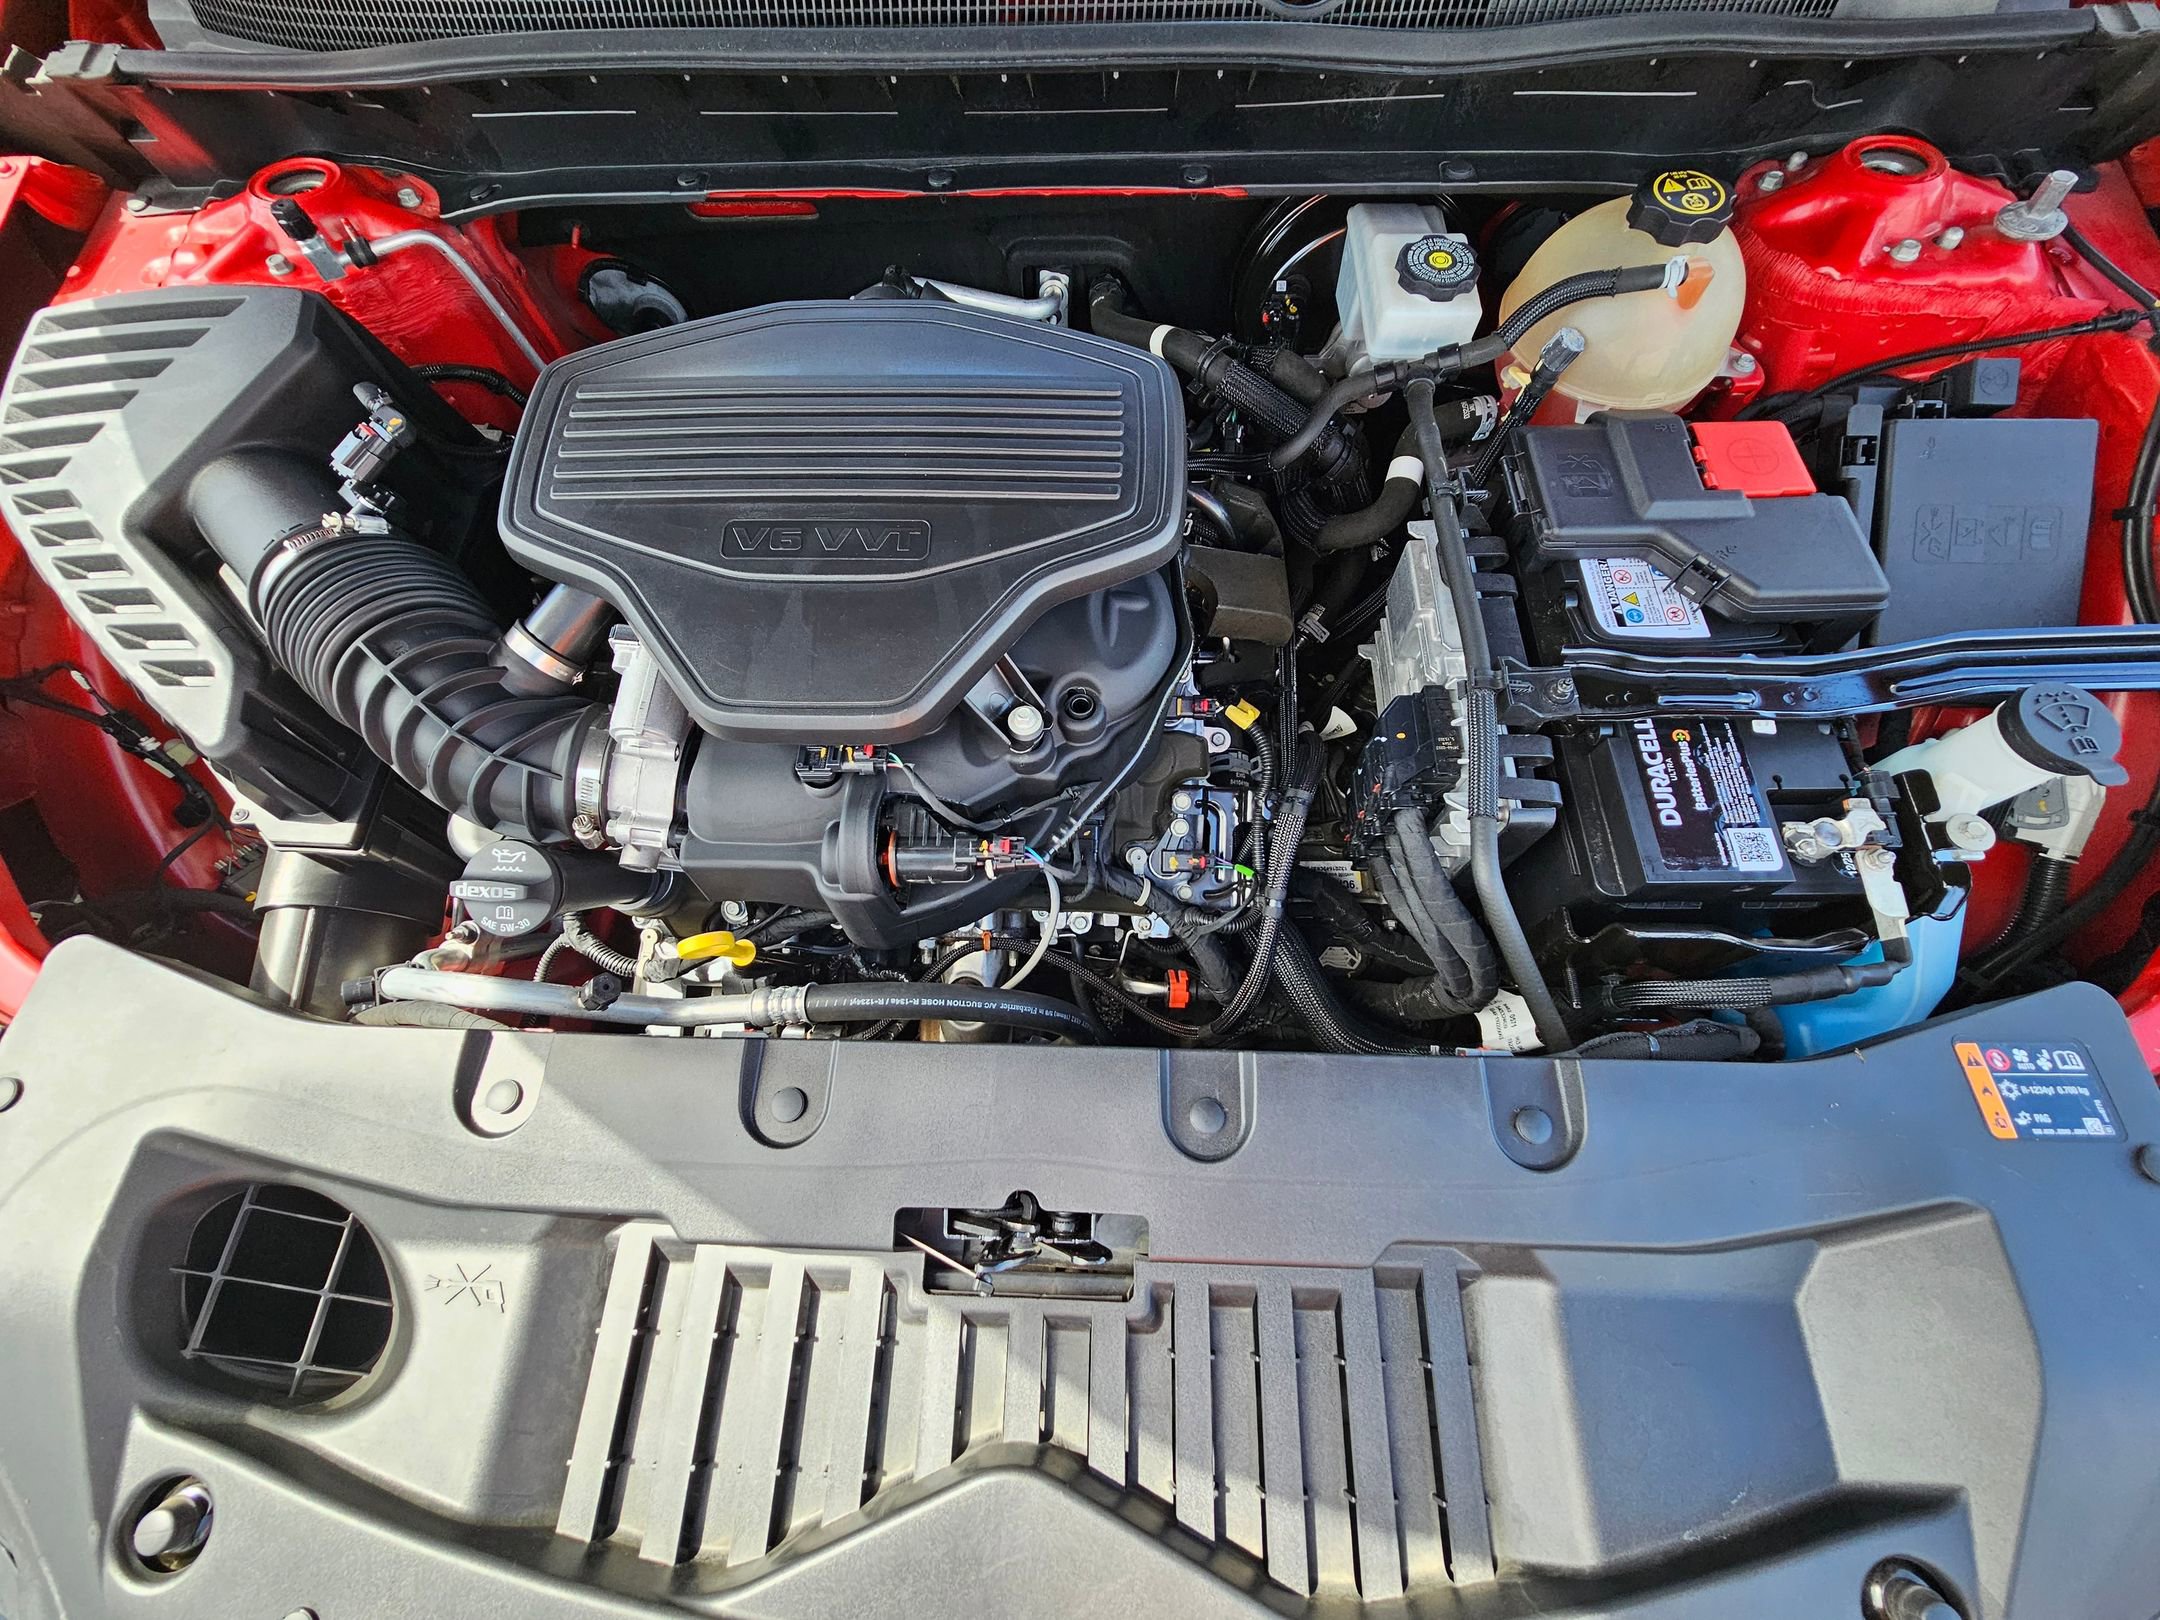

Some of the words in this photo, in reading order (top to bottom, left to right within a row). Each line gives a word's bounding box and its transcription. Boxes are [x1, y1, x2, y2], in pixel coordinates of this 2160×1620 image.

[733, 527, 802, 551] V6
[815, 527, 921, 551] VVT
[1634, 718, 1683, 826] DURACELL
[1665, 757, 1678, 781] ULTRA
[1840, 852, 1857, 874] 12/25
[455, 883, 517, 899] dexos
[481, 916, 497, 930] SAE
[500, 918, 530, 932] 5W-30
[921, 998, 945, 1006] HOSE
[946, 999, 982, 1009] SUCTION
[1000, 1002, 1038, 1015] Flexbarrier
